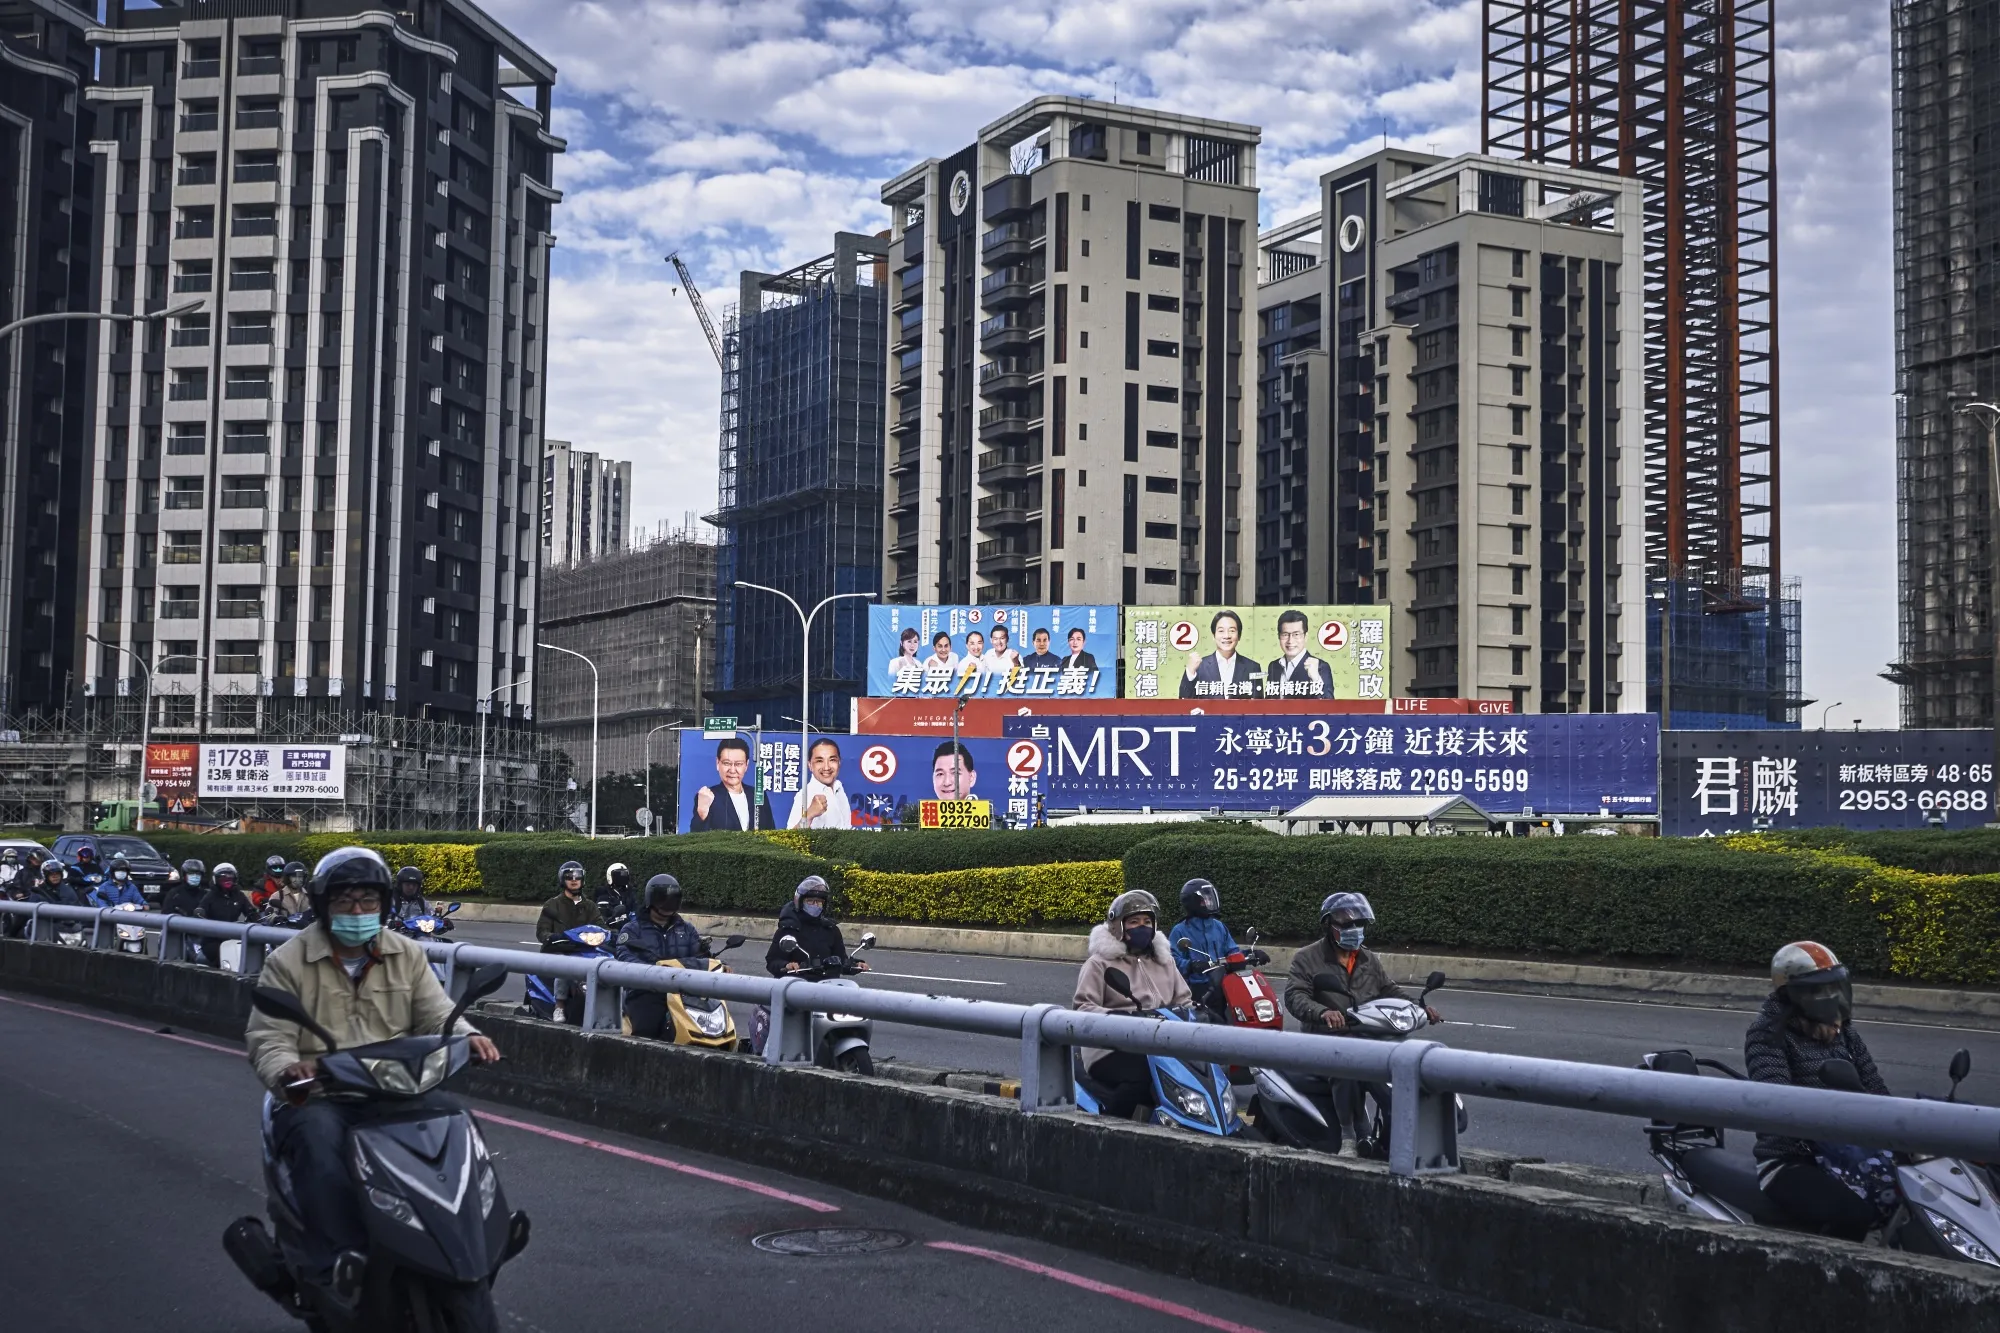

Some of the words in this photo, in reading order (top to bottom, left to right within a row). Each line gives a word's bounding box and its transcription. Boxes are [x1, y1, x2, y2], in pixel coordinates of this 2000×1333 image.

[971, 610, 979, 622] 3
[996, 610, 1005, 622] 2
[1176, 623, 1192, 645] 2
[1323, 623, 1343, 645] 2
[1134, 620, 1159, 698] 賴清德
[1359, 620, 1384, 698] 羅致政
[1395, 699, 1428, 711] LIFE
[1479, 703, 1510, 714] GIVE
[1215, 720, 1394, 756] 永寧站3分鐘
[1404, 727, 1529, 756] 近接未來
[152, 748, 191, 762] 文化風華
[869, 750, 887, 778] 3
[1015, 744, 1035, 772] 2
[236, 769, 270, 781] 雙衛浴
[783, 744, 800, 792] 侯友宜
[1839, 764, 1928, 783] 新板特區旁
[179, 780, 191, 788] 969
[295, 785, 339, 793] 2978-6000
[1214, 768, 1299, 792] 25-32坪
[1308, 768, 1402, 792] 即將落成
[1410, 768, 1529, 792] 2269-5599
[1691, 756, 1798, 817] 君麟
[940, 802, 976, 815] 0932-
[1839, 789, 1988, 811] 2953-6688
[922, 802, 939, 827] 租
[940, 815, 989, 828] 222790
